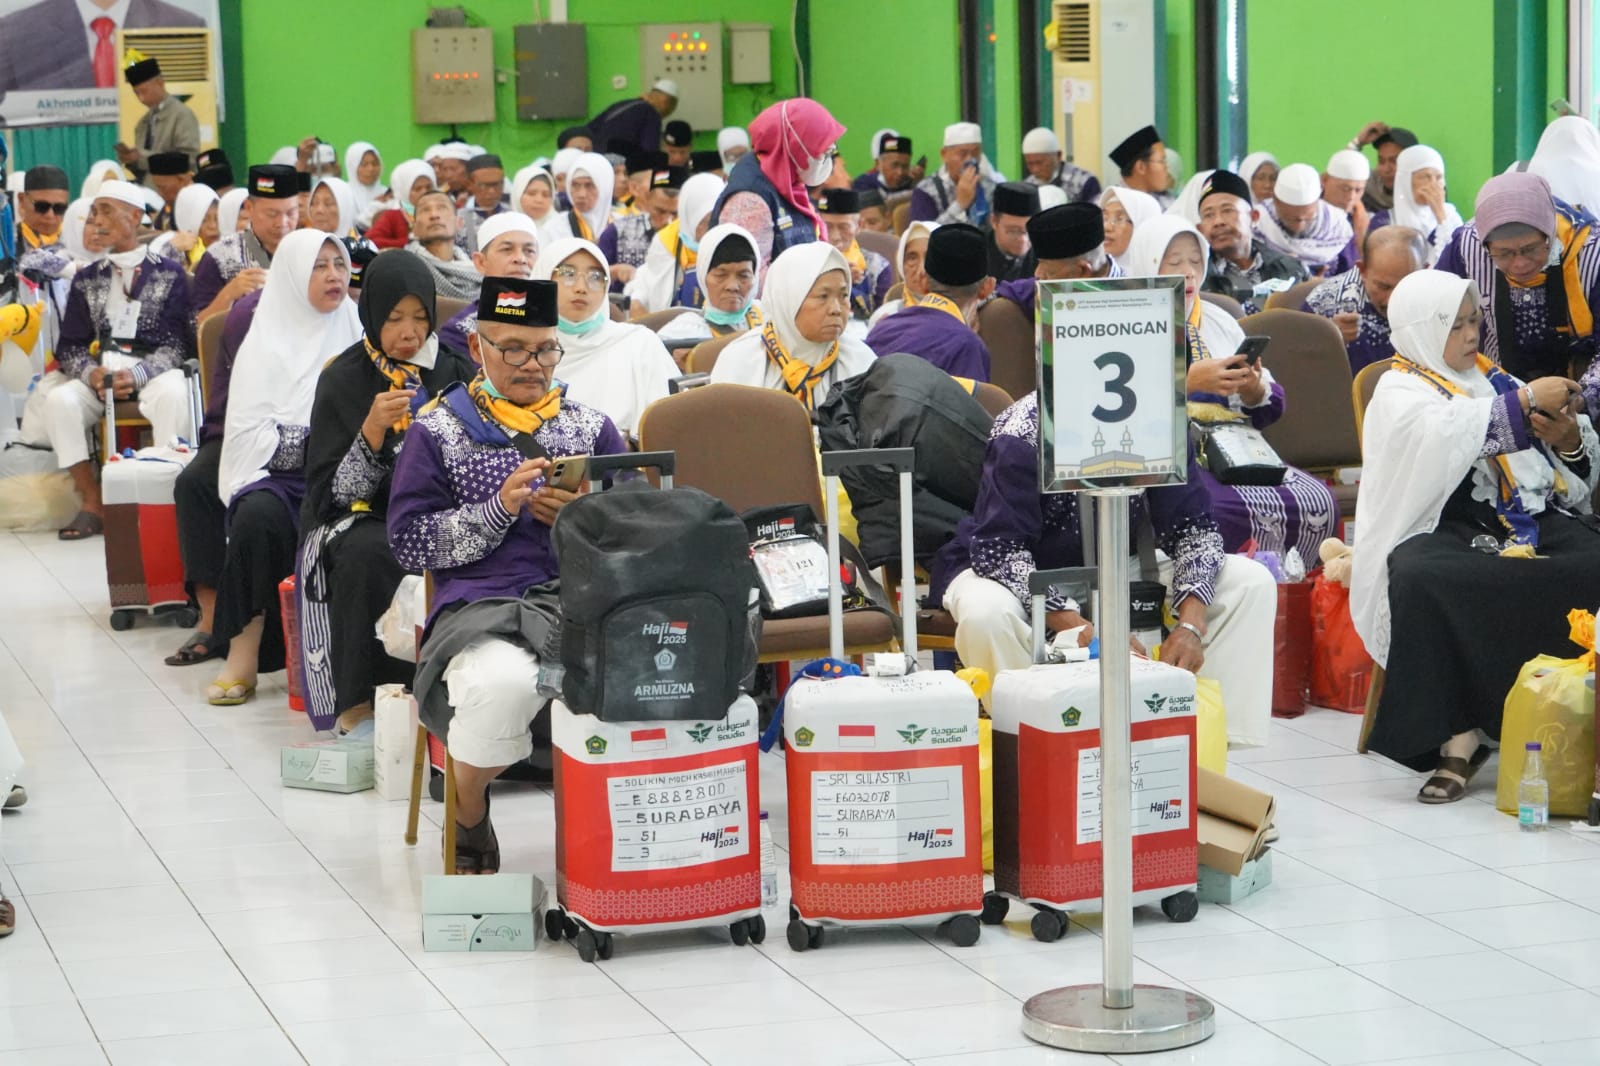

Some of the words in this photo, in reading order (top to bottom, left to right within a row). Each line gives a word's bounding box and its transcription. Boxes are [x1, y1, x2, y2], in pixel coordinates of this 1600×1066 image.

[1055, 321, 1168, 339] ROMBONGAN
[1091, 351, 1137, 423] 3
[757, 520, 779, 539] Haji
[795, 559, 815, 570] 121
[642, 622, 670, 644] Haji
[663, 635, 687, 644] 2025
[634, 682, 695, 696] ARMUZNA
[717, 731, 745, 741] Saudia
[931, 735, 962, 744] Saudia
[829, 772, 849, 786] SRI
[855, 771, 912, 785] SULASTRI
[636, 800, 742, 824] SURABAYA
[837, 809, 896, 822] SURABAYA
[1150, 799, 1169, 820] Haji
[1164, 811, 1182, 820] 2025
[640, 830, 656, 842] 51
[701, 828, 724, 848] Haji
[718, 838, 740, 848] 2025
[838, 828, 849, 837] 51
[907, 829, 934, 848] Haji
[928, 839, 953, 848] 2025
[640, 847, 650, 858] 3
[839, 847, 847, 857] 3
